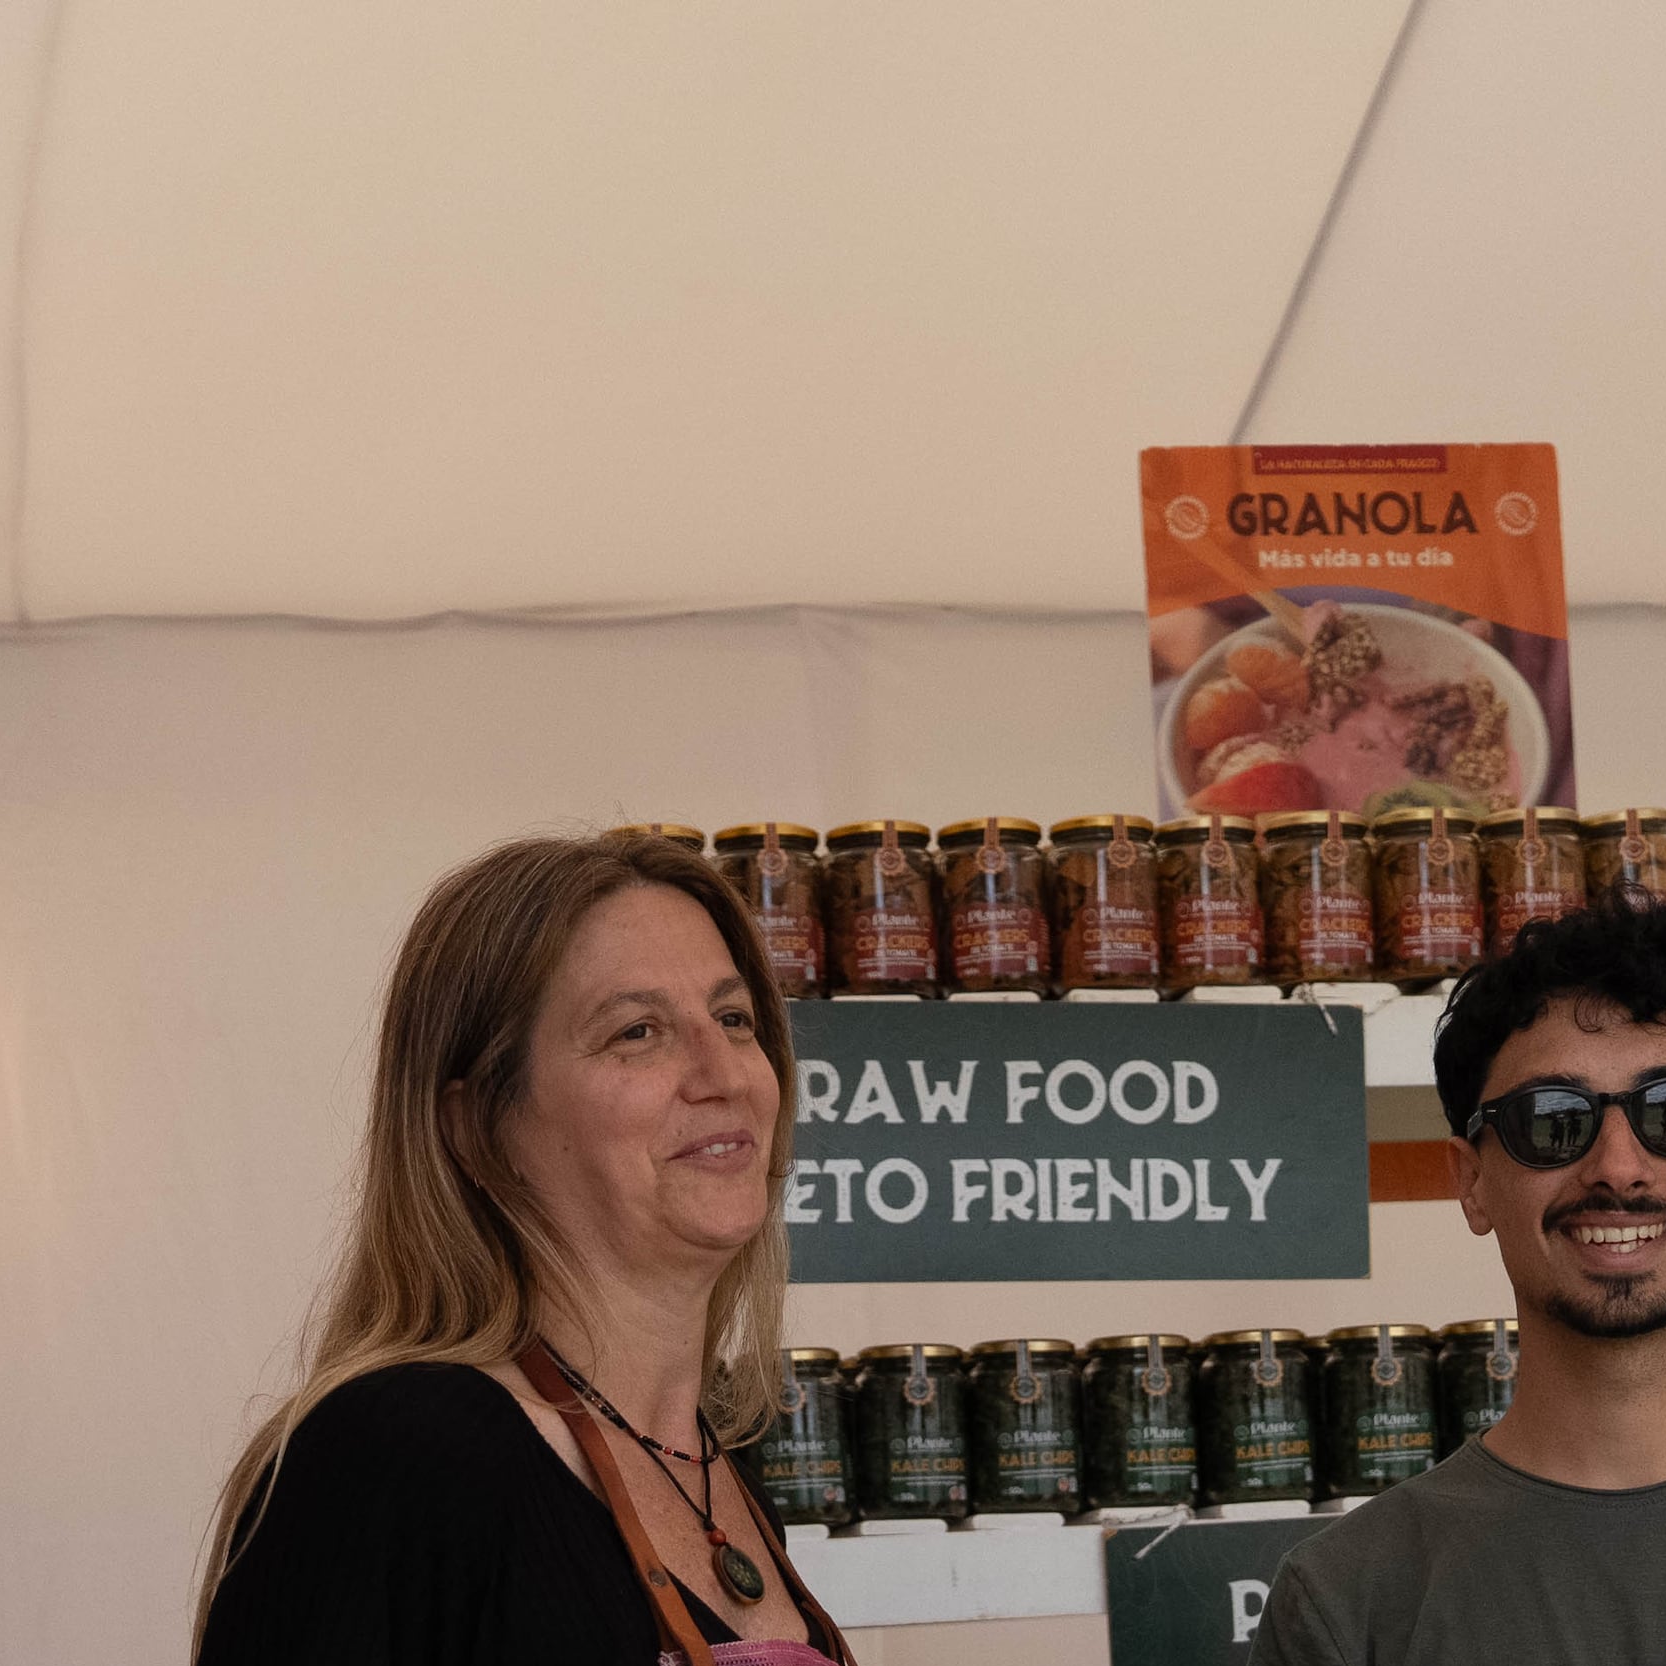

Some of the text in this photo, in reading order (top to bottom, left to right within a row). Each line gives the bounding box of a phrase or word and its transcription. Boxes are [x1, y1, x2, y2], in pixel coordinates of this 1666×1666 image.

[1226, 491, 1479, 537] GRANOLA
[1258, 548, 1306, 568] Más
[1309, 547, 1361, 568] vida
[1366, 551, 1380, 567] a
[1385, 548, 1412, 567] tu
[794, 1059, 1219, 1125] RAW FOOD
[785, 1158, 1283, 1223] ETO FRIENDLY
